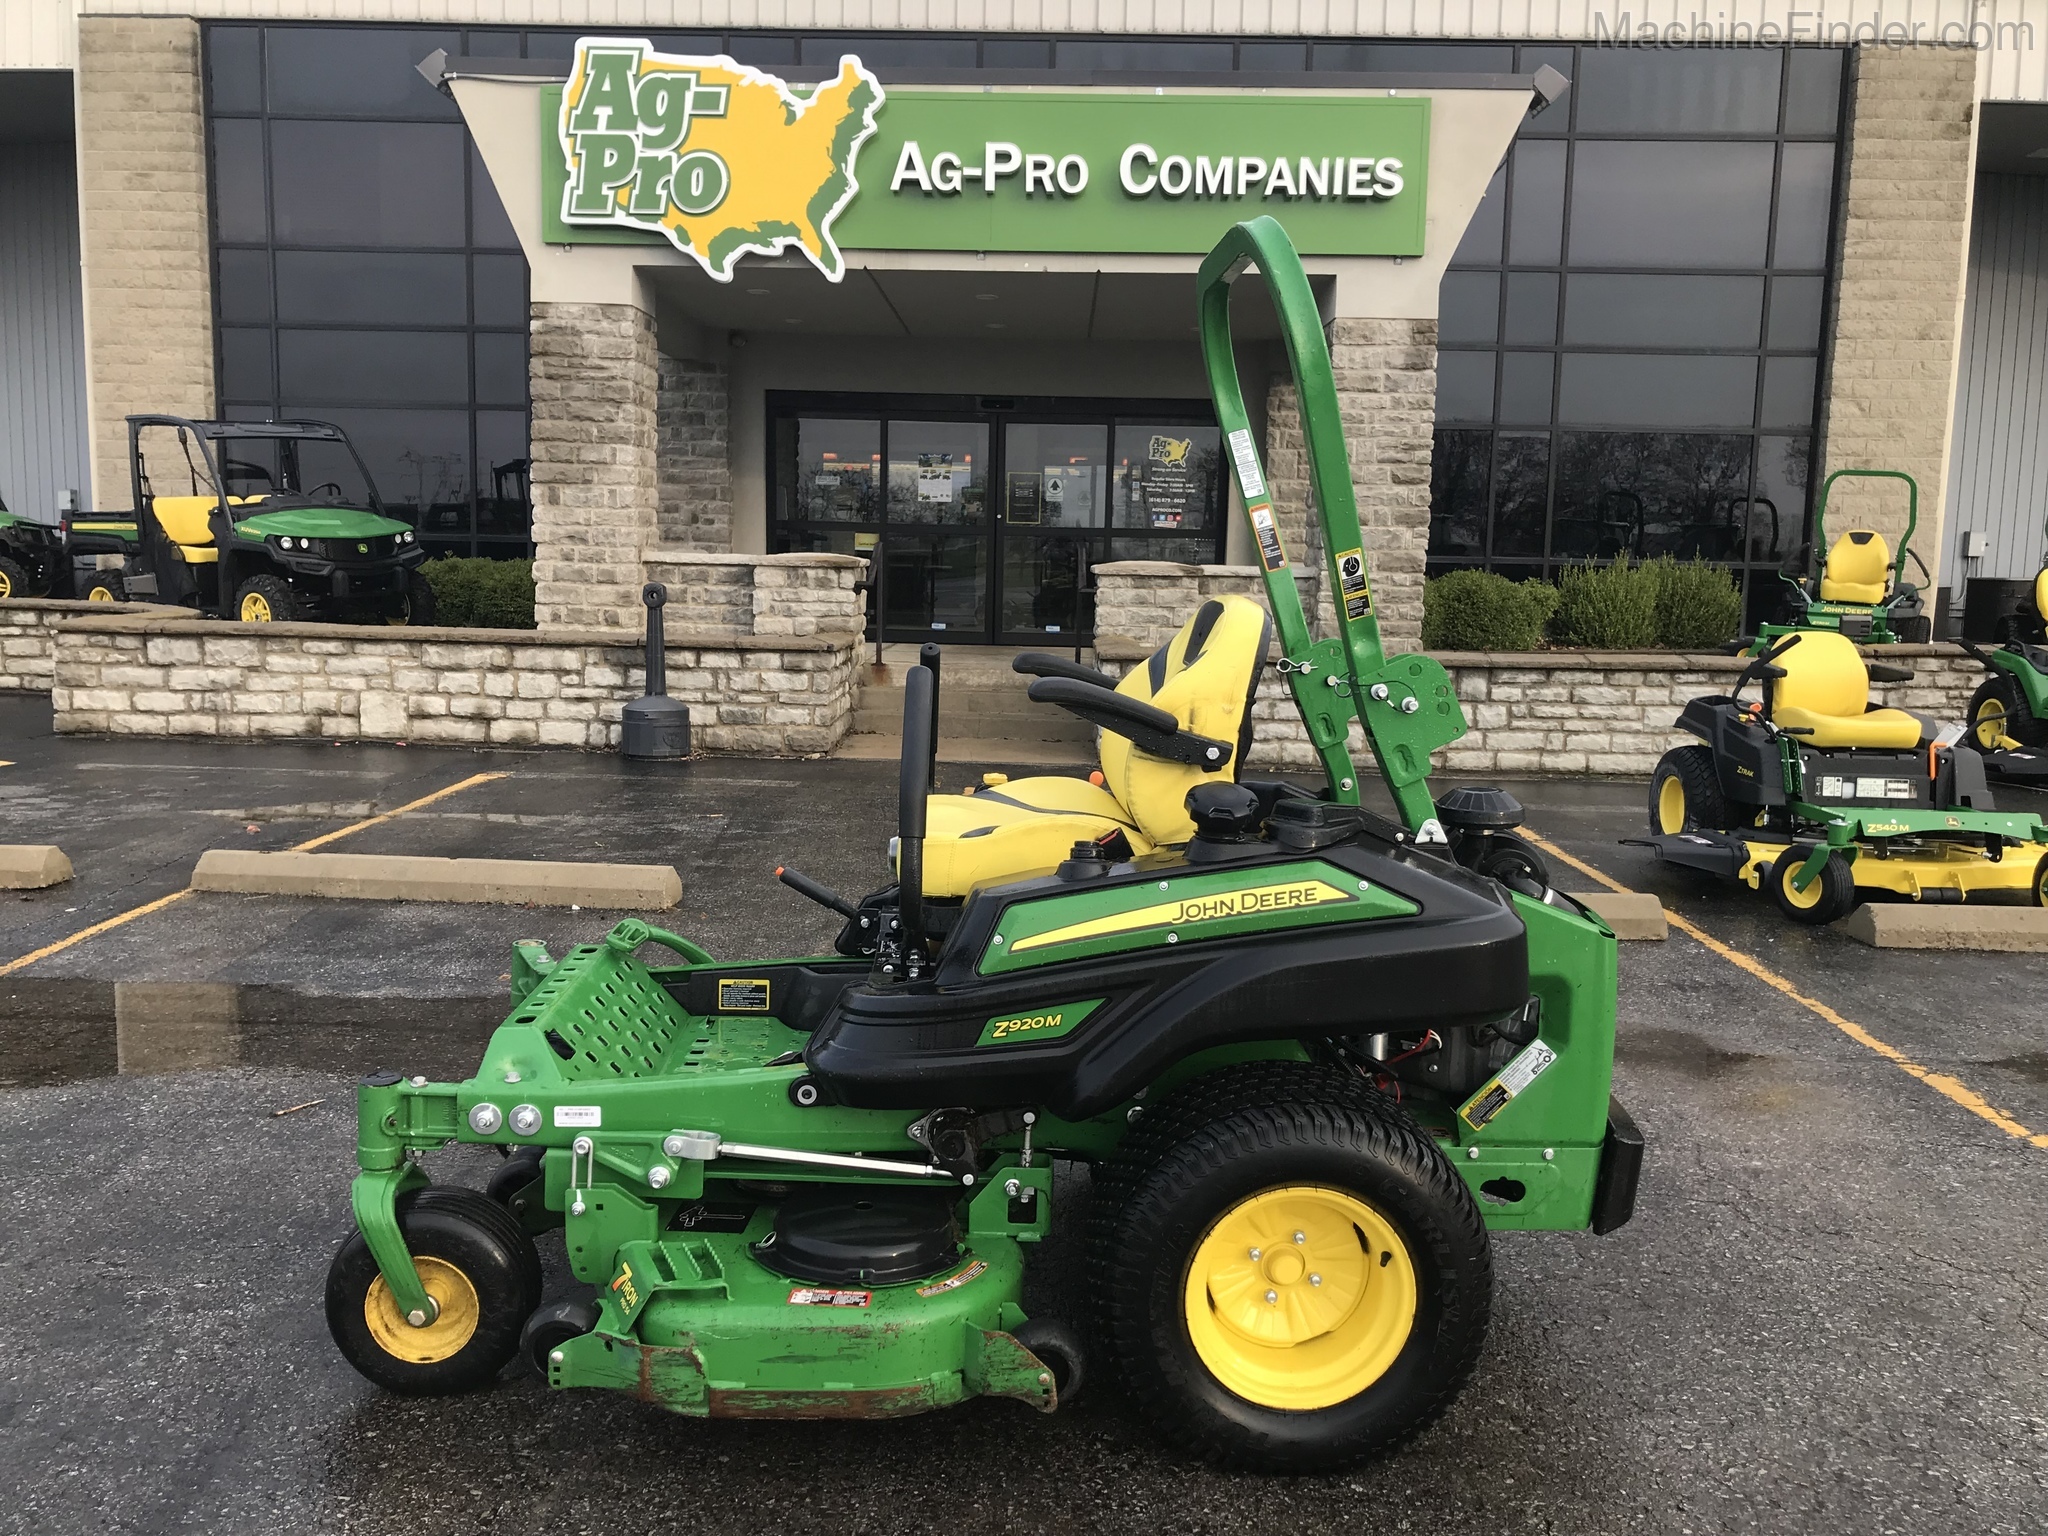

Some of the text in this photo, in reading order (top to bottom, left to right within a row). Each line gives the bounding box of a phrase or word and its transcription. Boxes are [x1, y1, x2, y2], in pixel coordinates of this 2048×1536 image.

[567, 47, 731, 153] Ag-
[568, 133, 731, 217] Pro
[1151, 447, 1171, 458] Pro
[1152, 437, 1171, 449] Ag-
[1821, 605, 1844, 613] JOHN
[1171, 887, 1318, 922] JOHN DEERE
